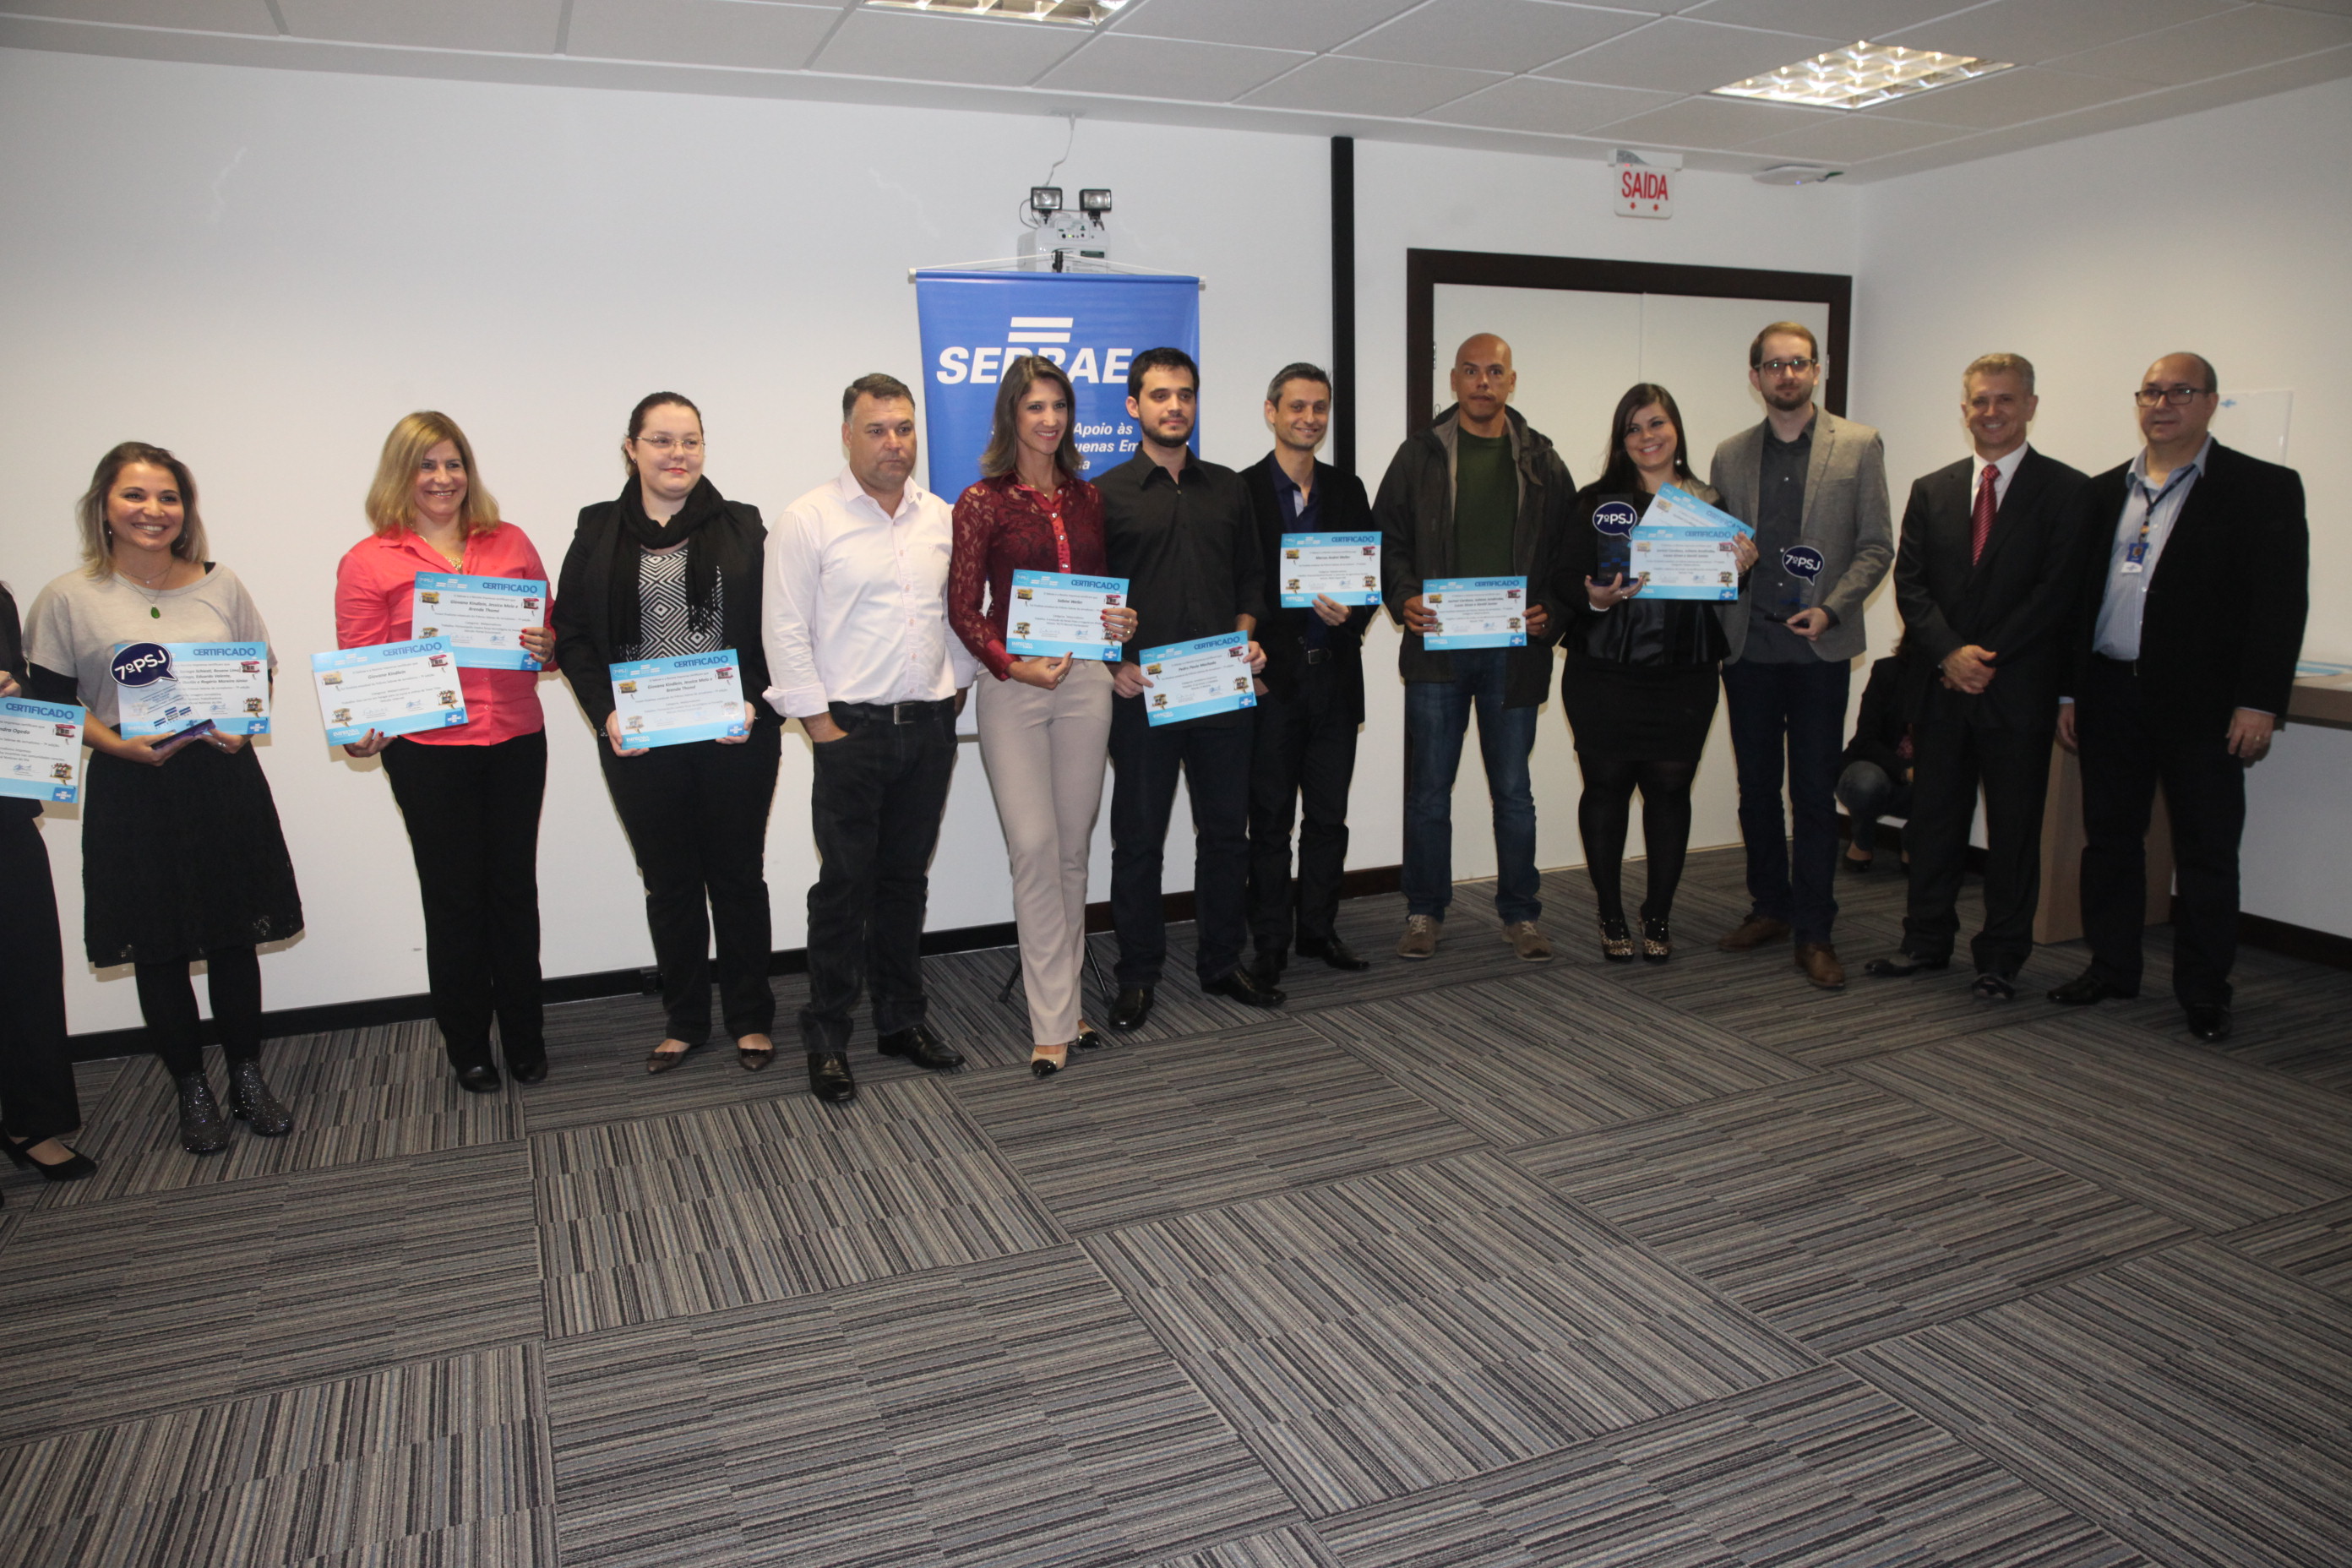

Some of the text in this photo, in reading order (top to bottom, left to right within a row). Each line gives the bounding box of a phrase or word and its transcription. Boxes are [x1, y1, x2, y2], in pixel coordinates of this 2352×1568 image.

[1074, 422, 1134, 438] Apoio às
[1685, 531, 1731, 539] CERTIFICADO
[482, 582, 538, 594] CERTIFICADO
[1071, 580, 1120, 591] CERTIFICADO
[383, 642, 442, 657] CERTIFICADO
[1194, 636, 1241, 651] CERTIFICADO
[193, 647, 257, 656] CERTIFICADO
[115, 650, 167, 680] 7ºPSJ
[674, 655, 729, 668] CERTIFICADO
[6, 702, 74, 720] CERTIFICADO
